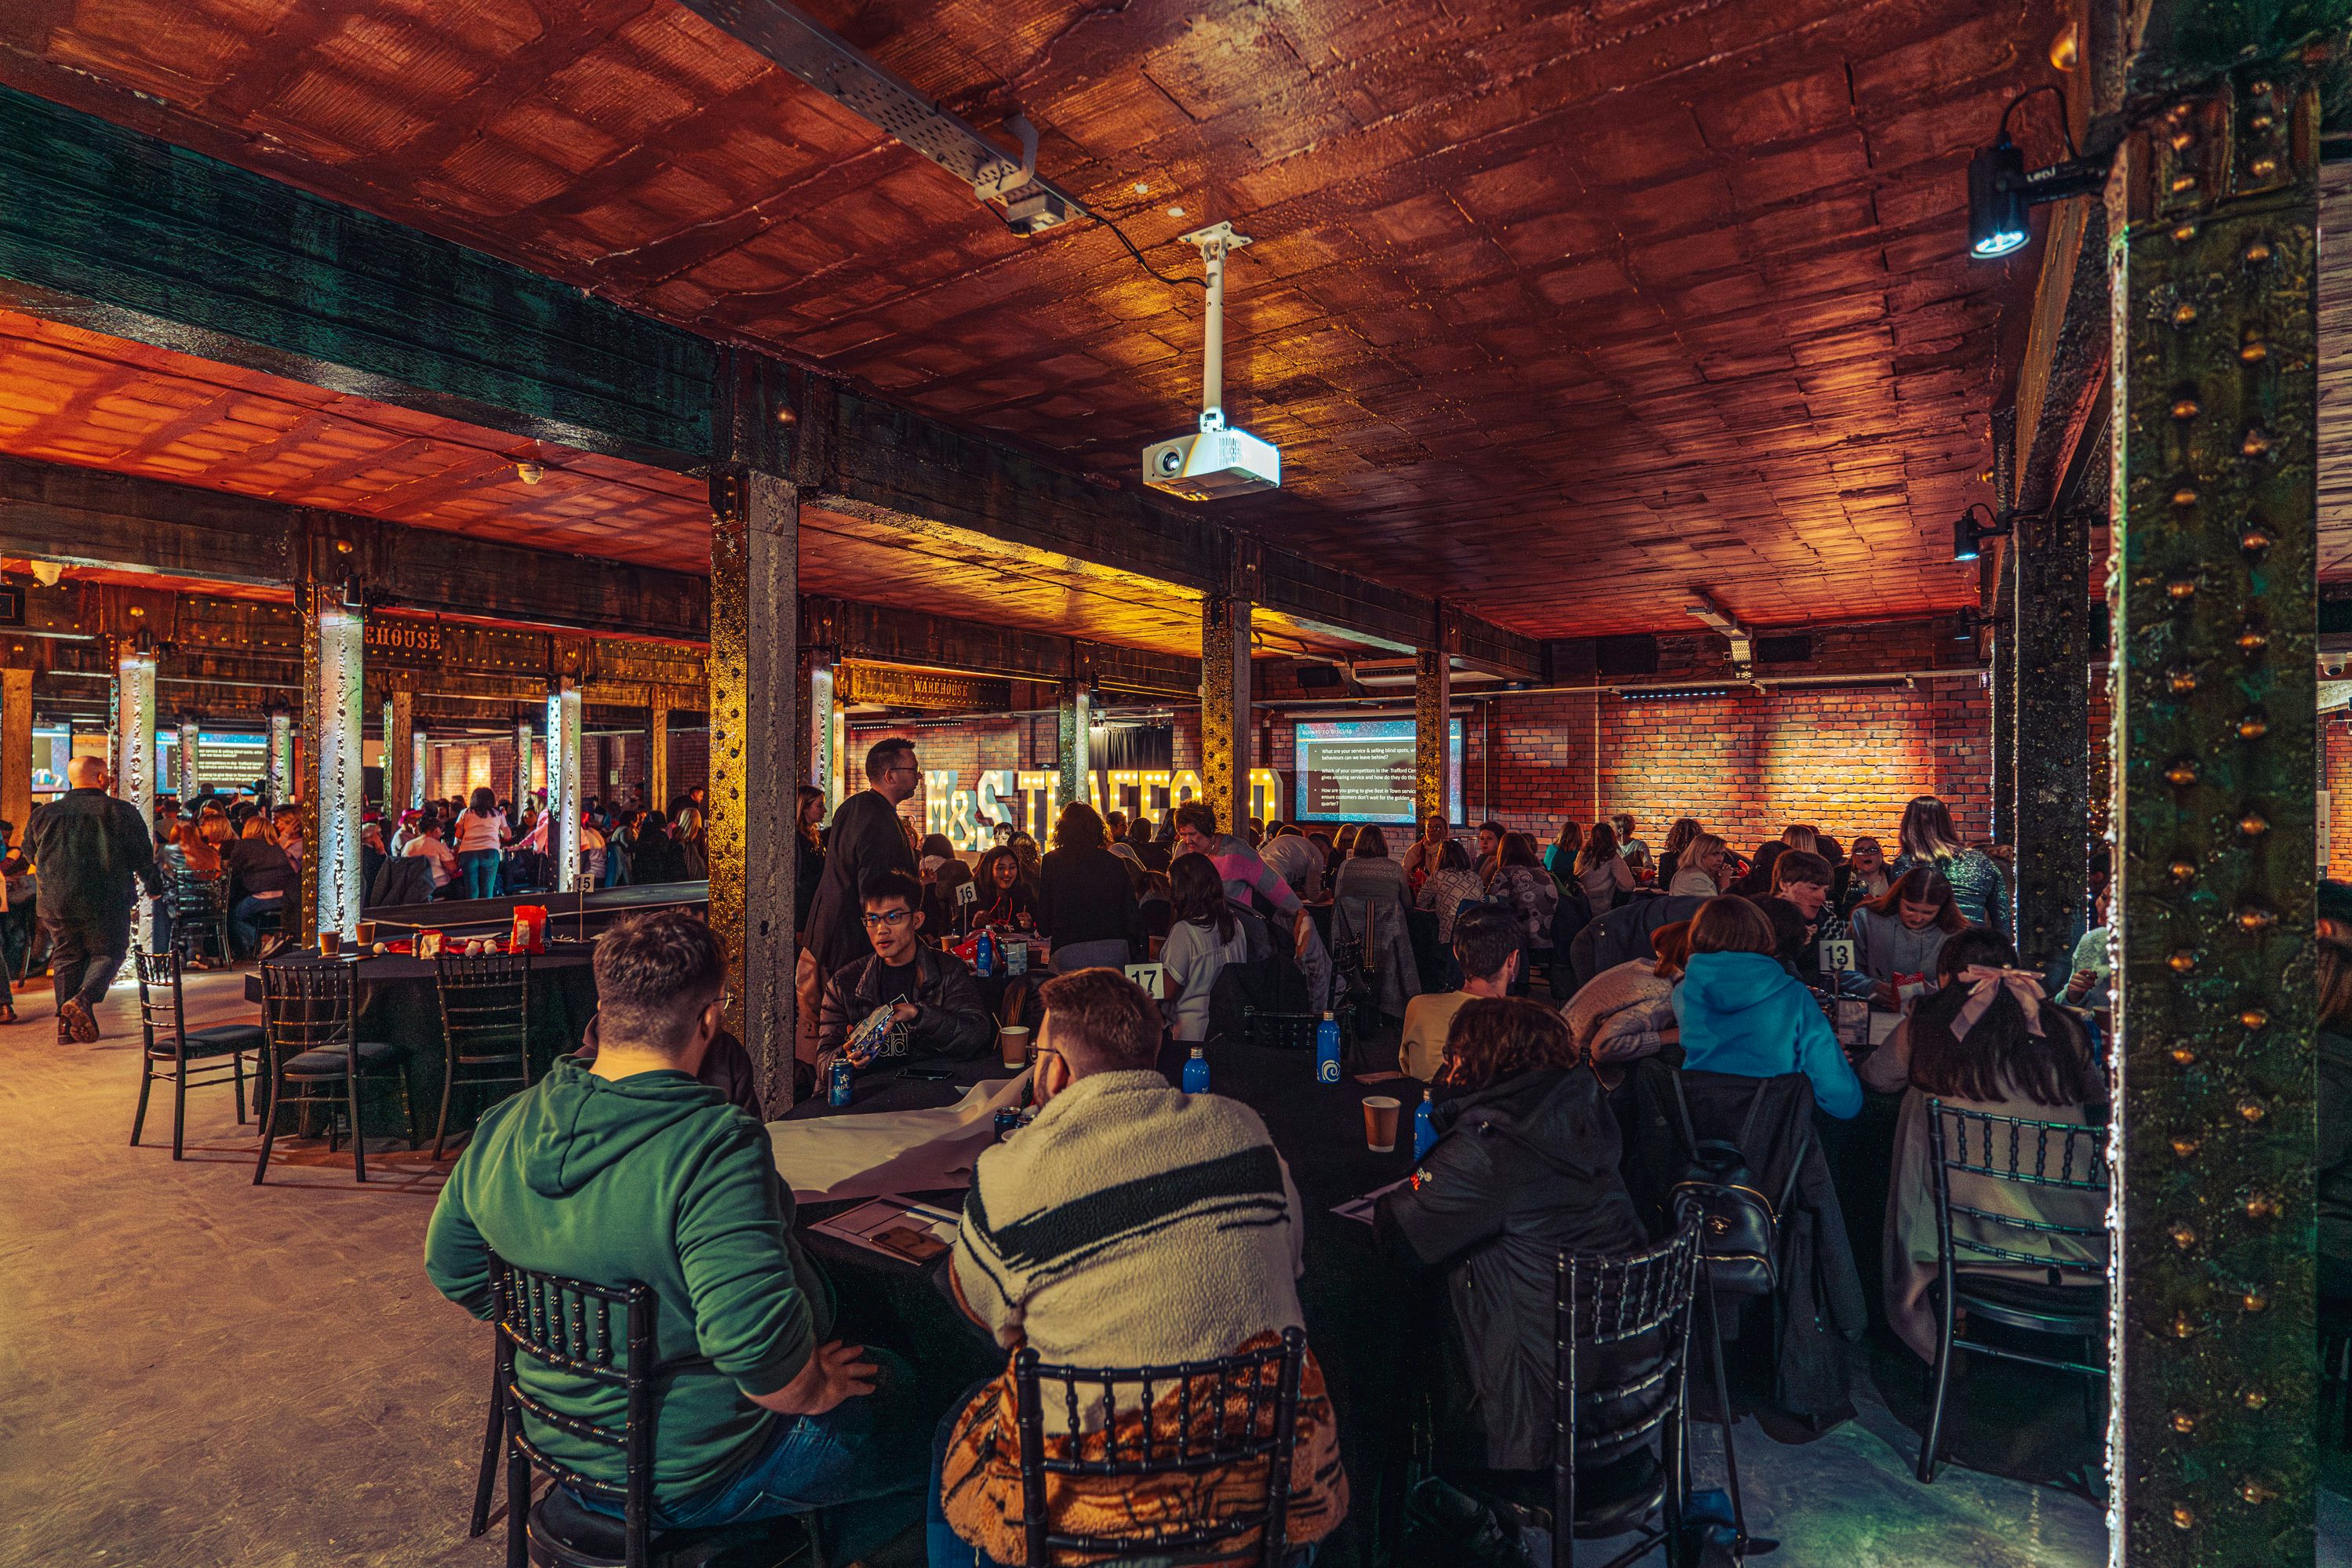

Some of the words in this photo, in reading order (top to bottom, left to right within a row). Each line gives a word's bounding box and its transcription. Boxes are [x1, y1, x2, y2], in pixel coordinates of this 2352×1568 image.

[914, 679, 967, 697] WAREHOUSE
[925, 770, 1013, 852] M&S
[577, 876, 591, 890] 15
[959, 886, 973, 903] 16
[1825, 944, 1848, 966] 13
[1131, 970, 1157, 994] 17
